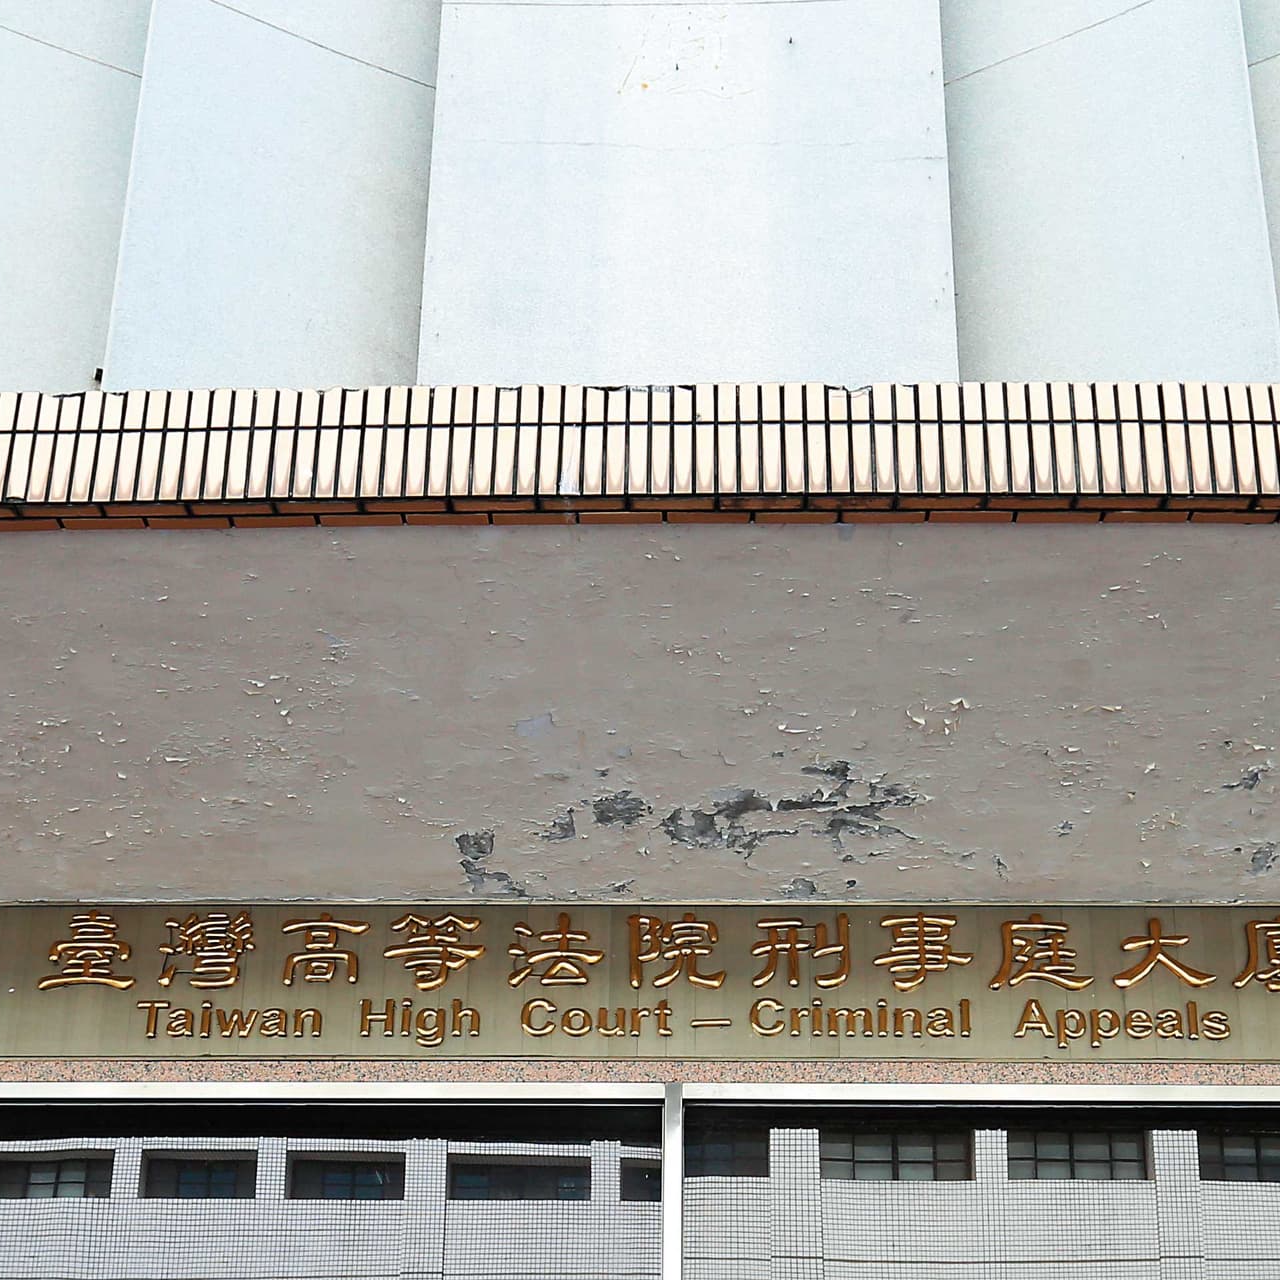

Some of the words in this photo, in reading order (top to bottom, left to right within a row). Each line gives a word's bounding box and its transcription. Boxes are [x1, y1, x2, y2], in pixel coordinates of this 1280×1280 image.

[136, 1000, 322, 1038] Taiwan
[359, 998, 480, 1047] High
[520, 998, 673, 1038] Court
[749, 998, 971, 1038] Criminal
[1013, 998, 1231, 1048] Appeals
